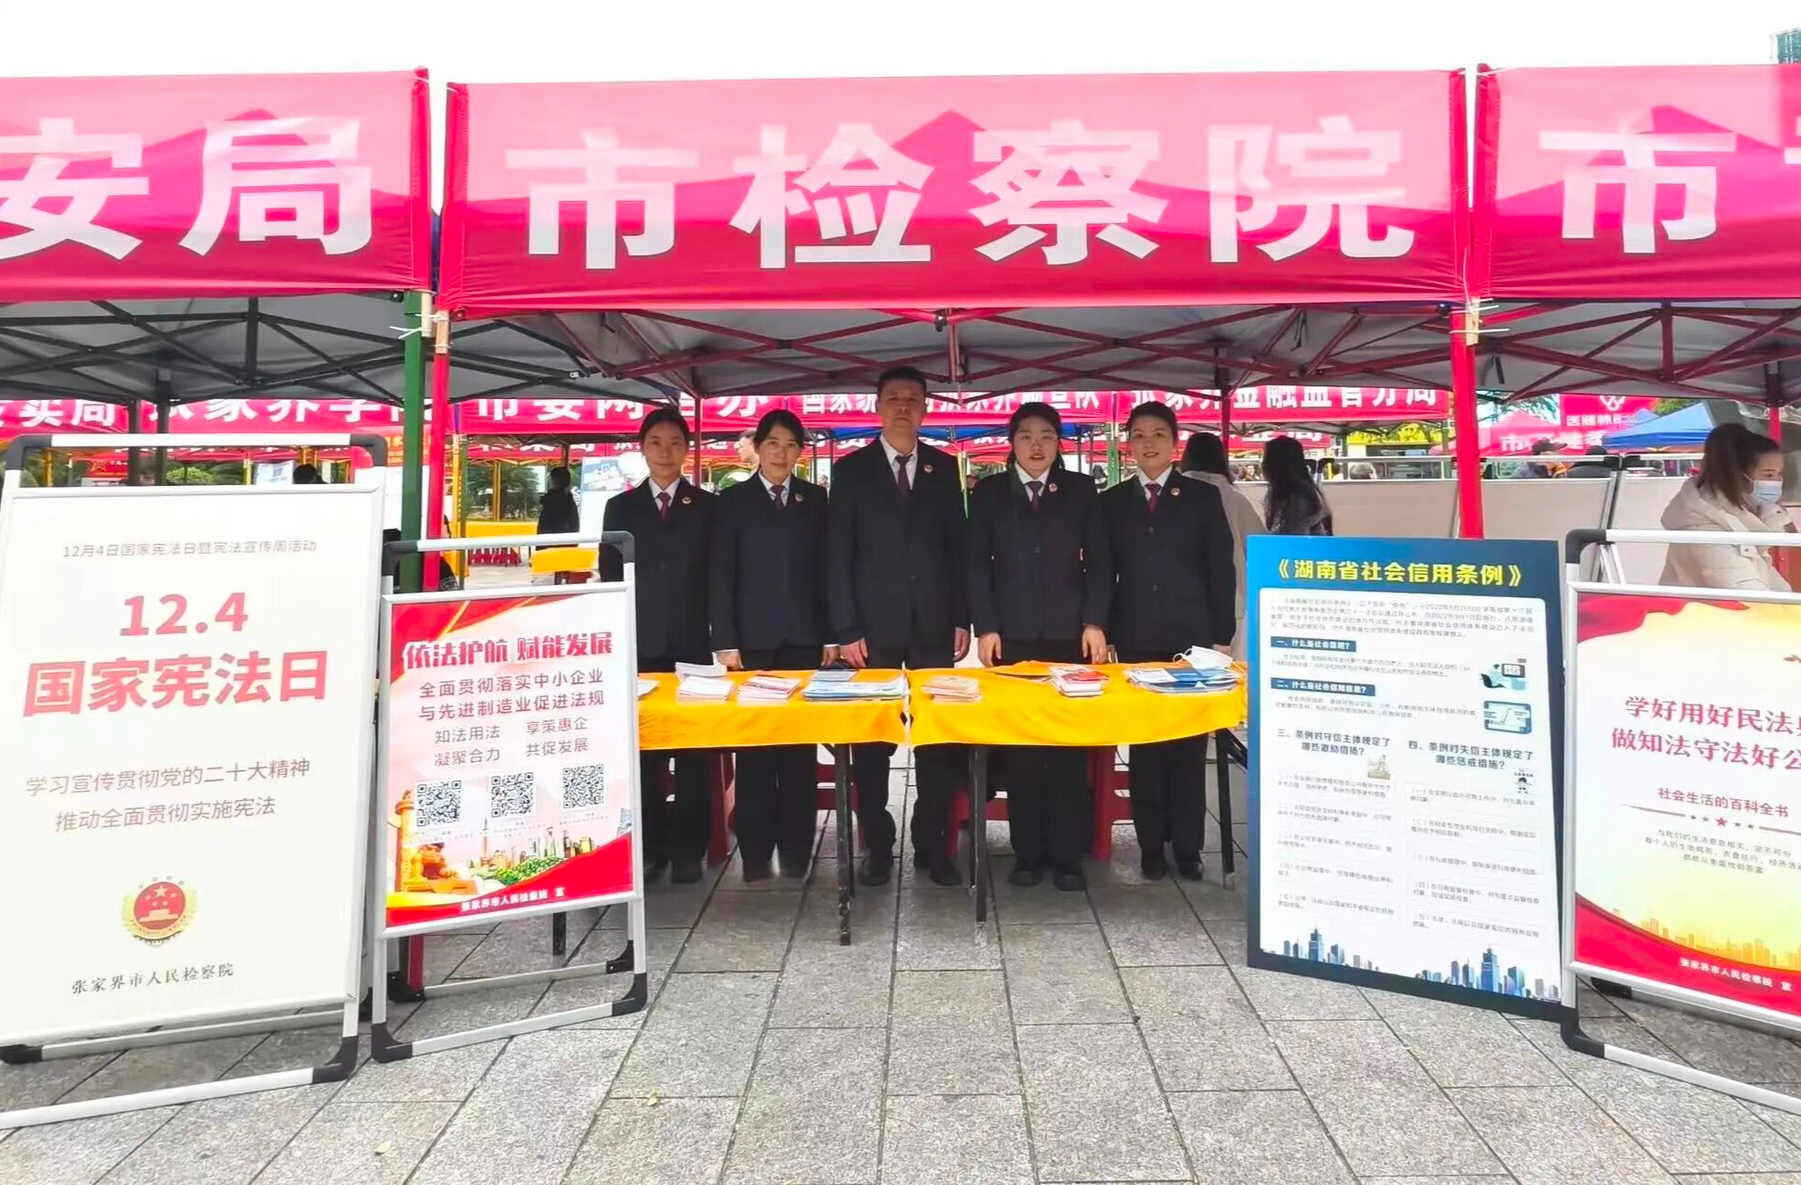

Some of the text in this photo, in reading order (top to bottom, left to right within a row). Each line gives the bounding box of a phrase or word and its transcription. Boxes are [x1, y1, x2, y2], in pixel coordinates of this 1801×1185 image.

[0, 116, 373, 260] 安局
[505, 115, 1415, 270] 市检察院
[1539, 118, 1801, 253] 市
[62, 539, 318, 558] 12月4日国家宪法日暨宪法宣传周活动
[1277, 558, 1523, 587] 《湖南省社会信用条例》
[119, 591, 249, 636] 12.4
[405, 631, 613, 670] 依法护航 赋能发展
[23, 649, 328, 717] 国家宪法日
[418, 668, 605, 699] 全面贯彻落实中小企业
[418, 690, 605, 722] 与先进制造业促进法规
[1624, 695, 1801, 737] 学好用好民法
[434, 716, 588, 745] 知法用法 享策惠企
[433, 737, 589, 767] 凝聚合力 共促发展
[25, 757, 311, 798] 学习宣传贯彻党的二十大精神
[54, 795, 276, 834] 推动全面贯彻实施宪法
[1657, 786, 1790, 818] 社会生活的百科全书
[70, 963, 235, 995] 张家界市人民检察院
[1679, 957, 1773, 988] 张家界市人民检察院
